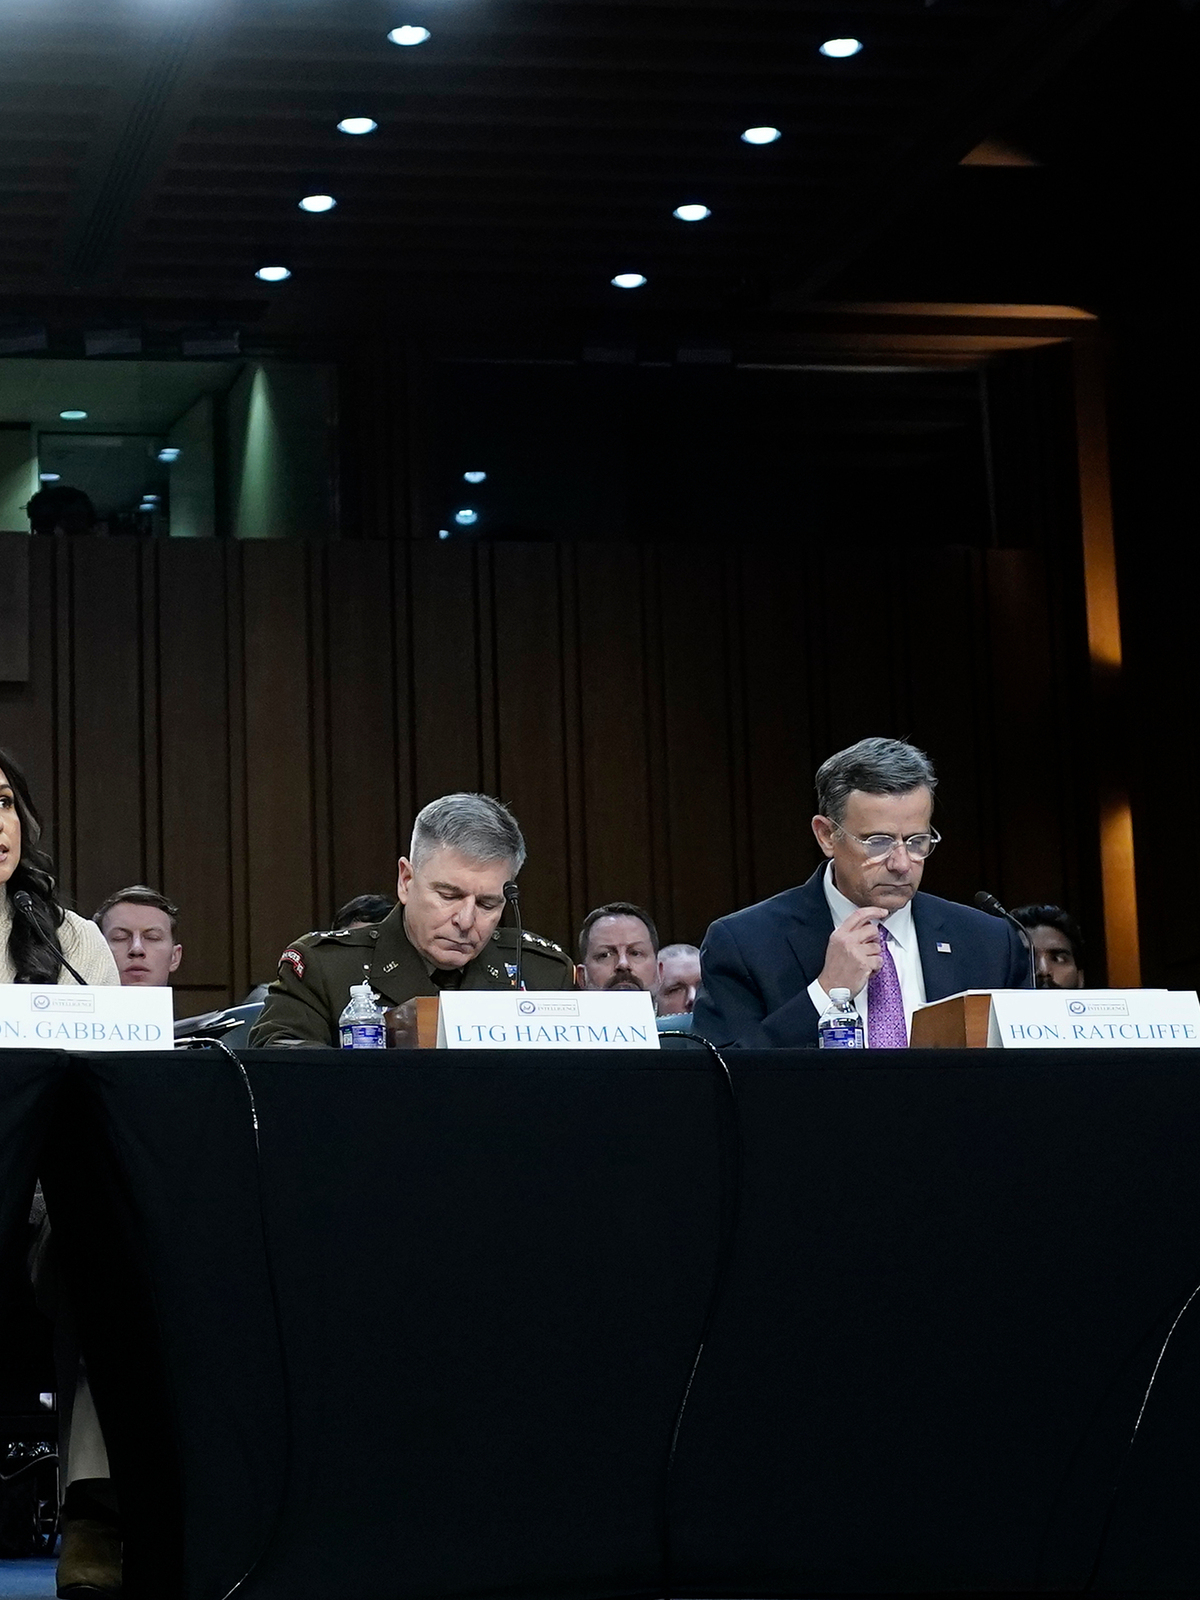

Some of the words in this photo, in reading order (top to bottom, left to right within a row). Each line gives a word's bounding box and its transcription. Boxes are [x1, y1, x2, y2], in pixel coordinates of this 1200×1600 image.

[35, 1021, 162, 1042] GABBARD
[456, 1024, 507, 1043] LTG
[515, 1025, 648, 1043] HARTMAN
[1009, 1023, 1067, 1040] HON.
[1073, 1023, 1198, 1040] RATCLIFFE
